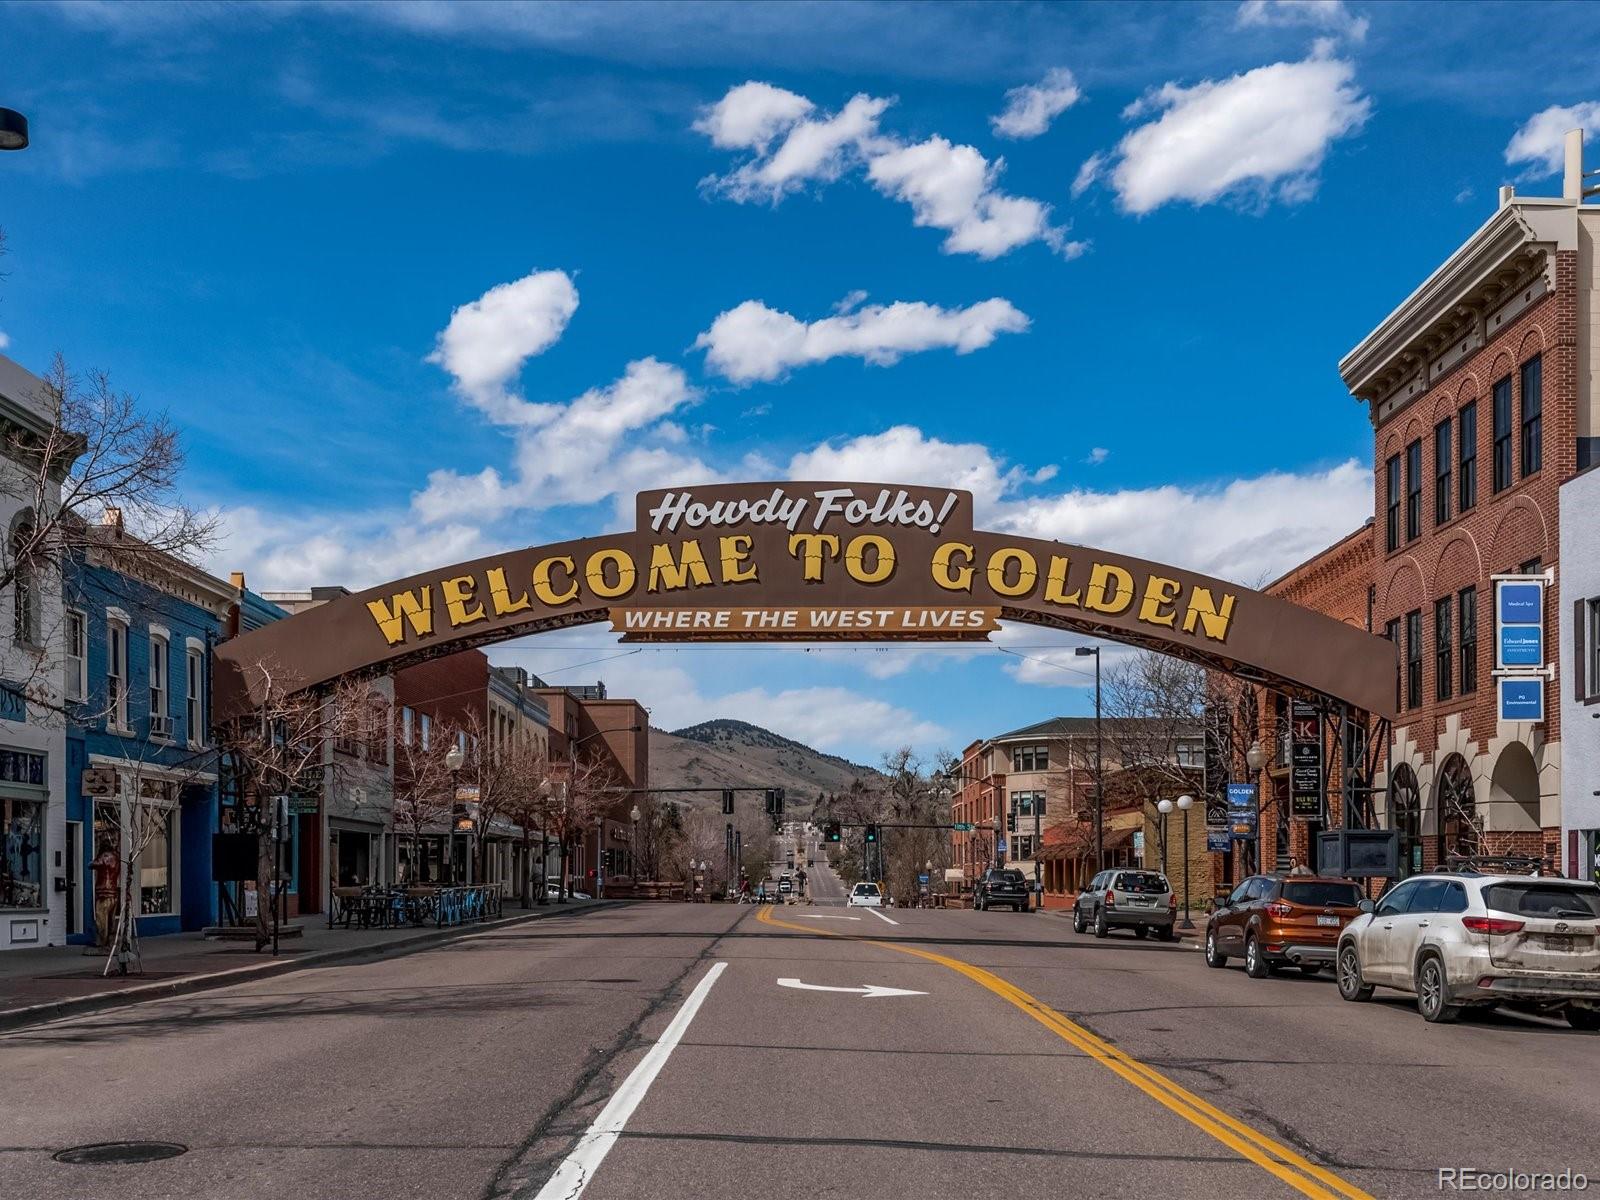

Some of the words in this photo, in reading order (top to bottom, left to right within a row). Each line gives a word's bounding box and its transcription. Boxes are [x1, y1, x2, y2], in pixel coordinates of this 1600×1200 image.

[649, 488, 808, 532] Howdy
[812, 488, 958, 534] Folks!
[366, 533, 761, 645] WELCOME
[787, 533, 895, 584] TO
[930, 541, 1236, 641] GOLDEN
[624, 610, 730, 628] WHERE
[741, 610, 798, 628] THE
[809, 609, 894, 628] WEST
[901, 609, 985, 627] LIVES
[1300, 721, 1314, 738] K
